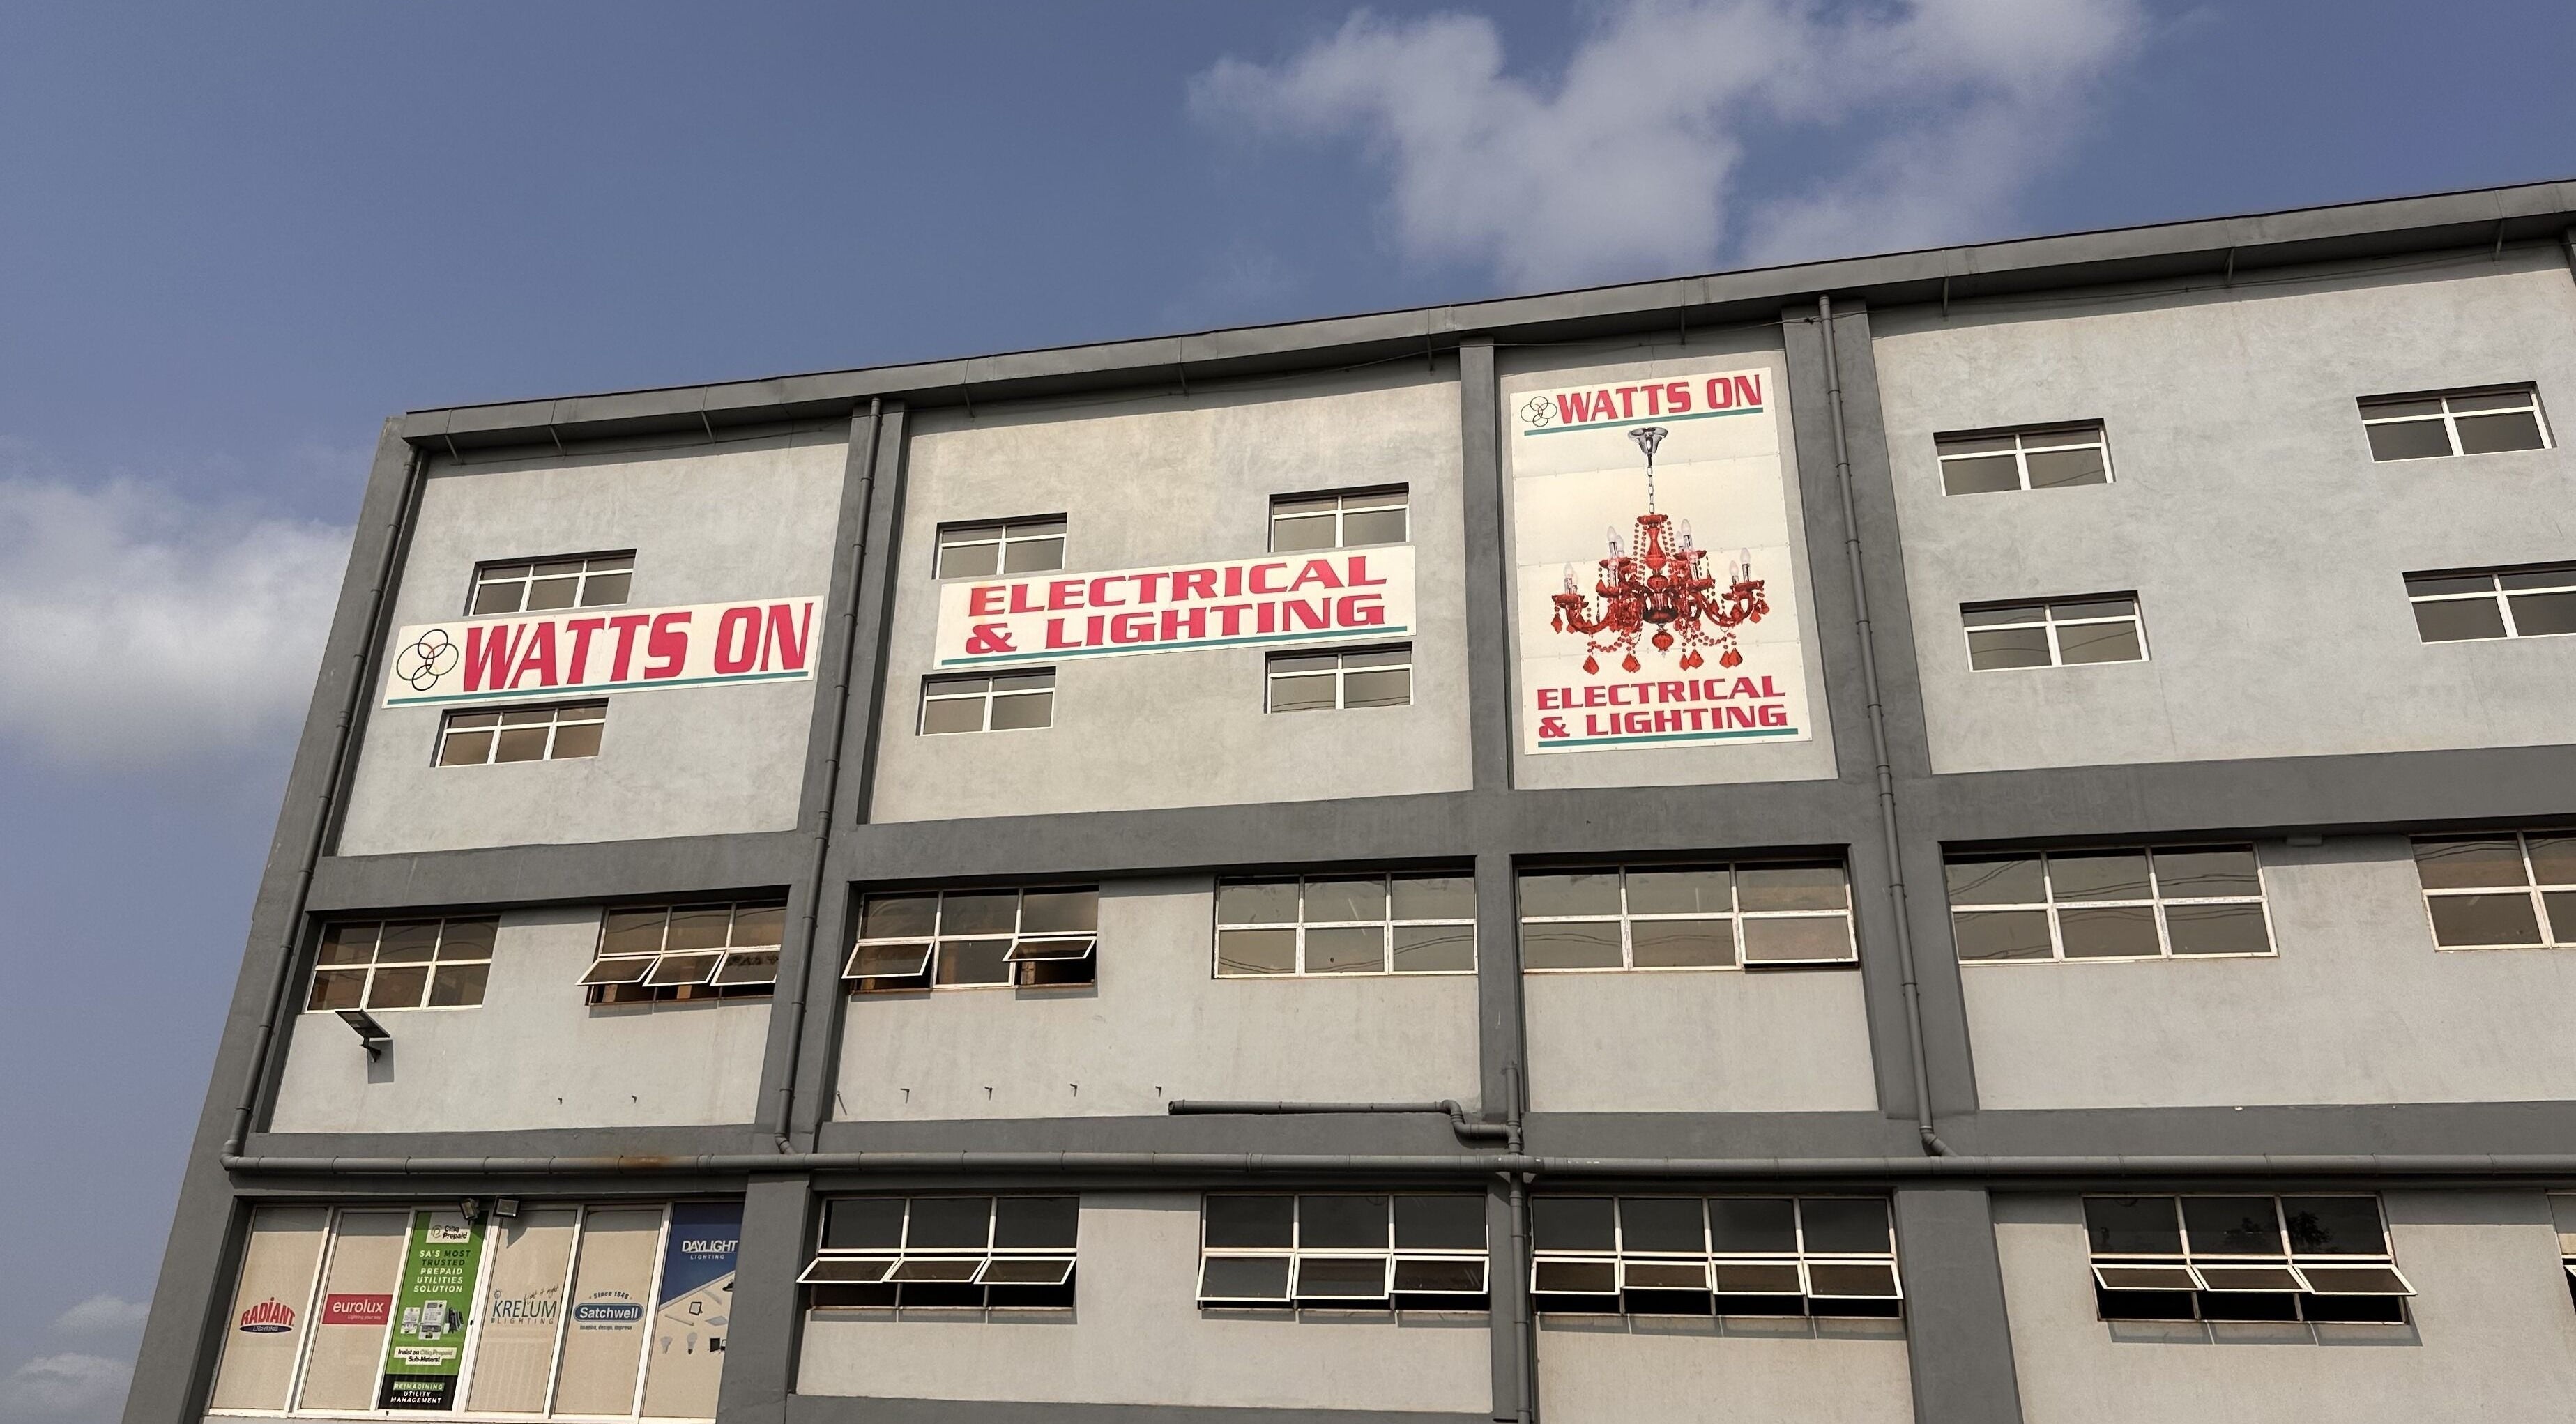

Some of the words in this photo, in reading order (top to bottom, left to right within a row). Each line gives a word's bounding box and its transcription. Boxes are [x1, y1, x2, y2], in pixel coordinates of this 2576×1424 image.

[1556, 381, 1691, 424] WATTS
[1706, 374, 1762, 409] ON
[964, 555, 1387, 618] ELECTRICAL
[965, 622, 1016, 654] &
[1045, 593, 1385, 650] LIGHTING
[463, 611, 692, 692] WATTS
[713, 602, 813, 675] ON
[1537, 675, 1786, 710] ELECTRICAL
[1538, 716, 1569, 739] &
[1586, 704, 1788, 736] LIGHTING
[681, 1240, 738, 1252] DAYLIGHT
[241, 1296, 296, 1325] RADIANT
[333, 1299, 385, 1314] eurolux
[492, 1300, 557, 1317] KRELUM
[579, 1307, 639, 1319] Satchwell
